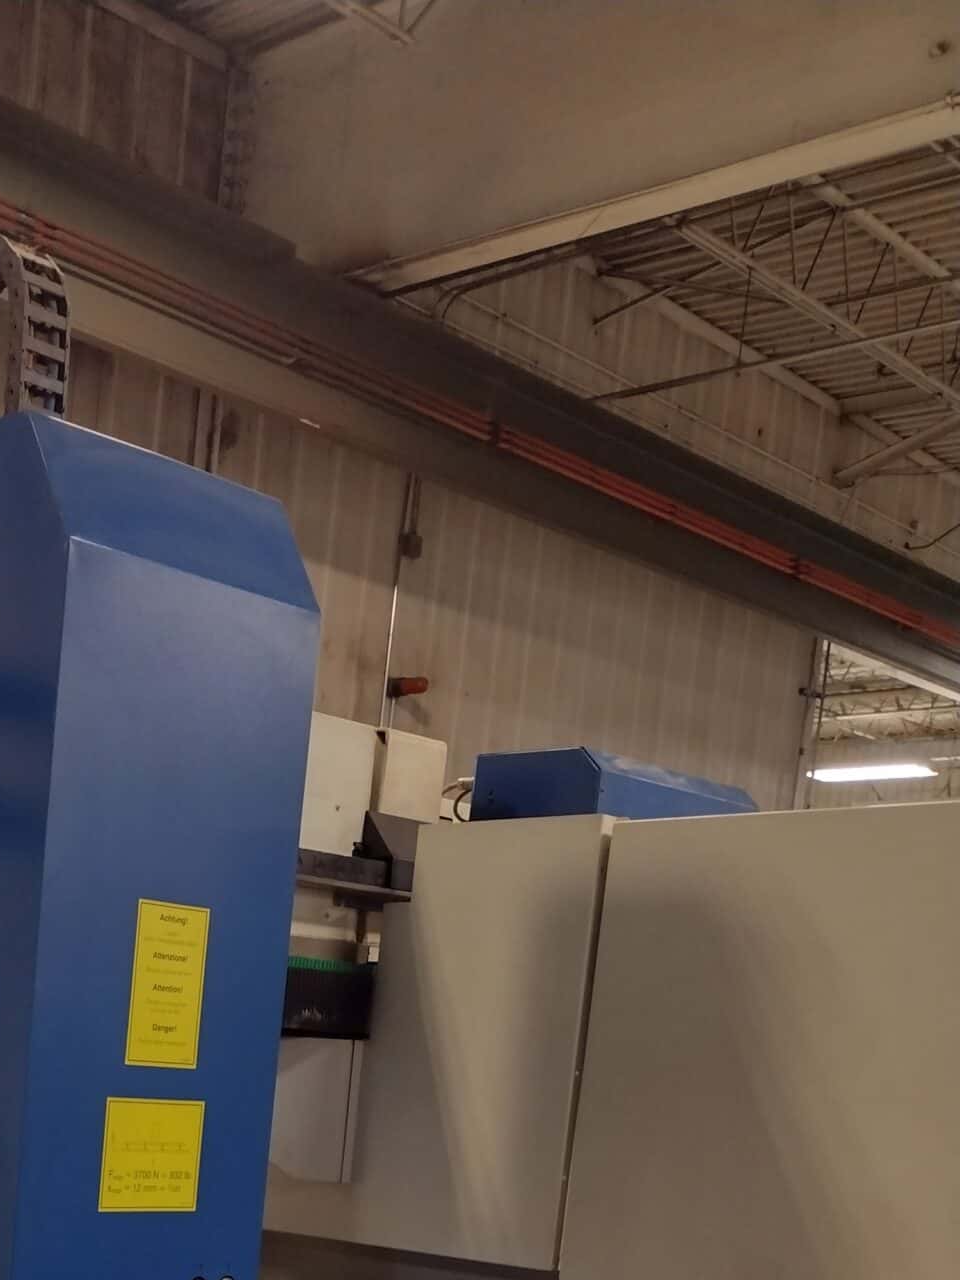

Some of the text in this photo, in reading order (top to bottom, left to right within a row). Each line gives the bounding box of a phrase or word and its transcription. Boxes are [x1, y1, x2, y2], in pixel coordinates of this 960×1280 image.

[159, 913, 189, 927] Achtung!
[152, 951, 189, 963] Attenzione!
[152, 982, 184, 994] Attention!
[152, 1023, 177, 1034] Danger!
